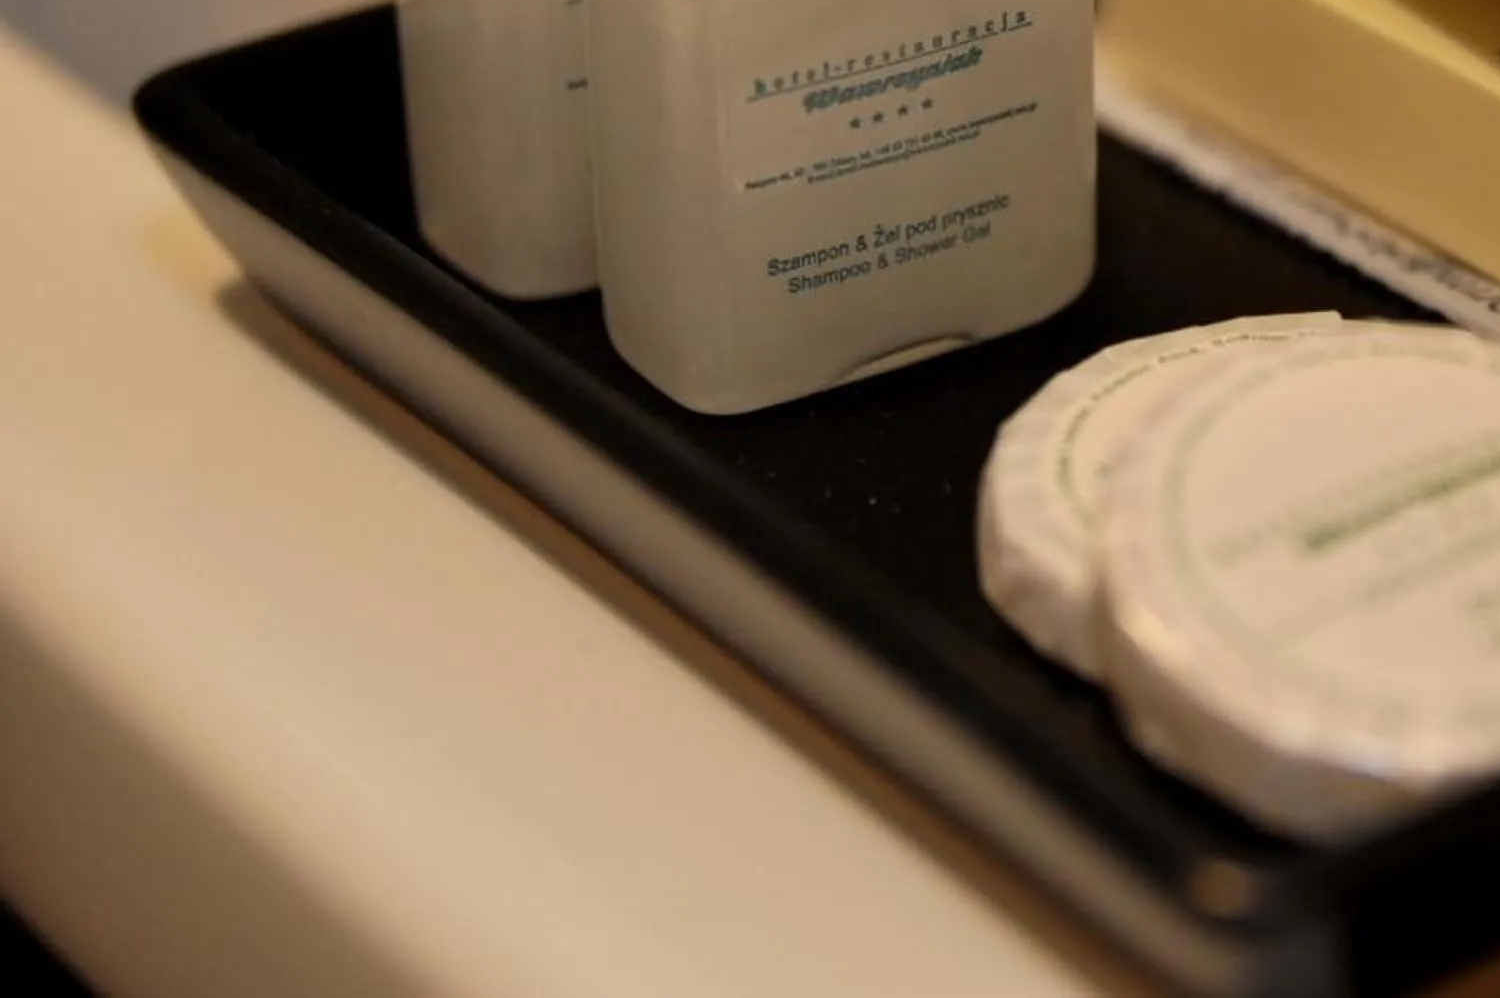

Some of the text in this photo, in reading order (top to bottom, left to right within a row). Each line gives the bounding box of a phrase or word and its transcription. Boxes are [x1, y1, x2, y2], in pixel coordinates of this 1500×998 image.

[768, 193, 1011, 277] Szampon & Żel pod prysznic
[788, 221, 992, 295] Shampoo & Shower Gel
